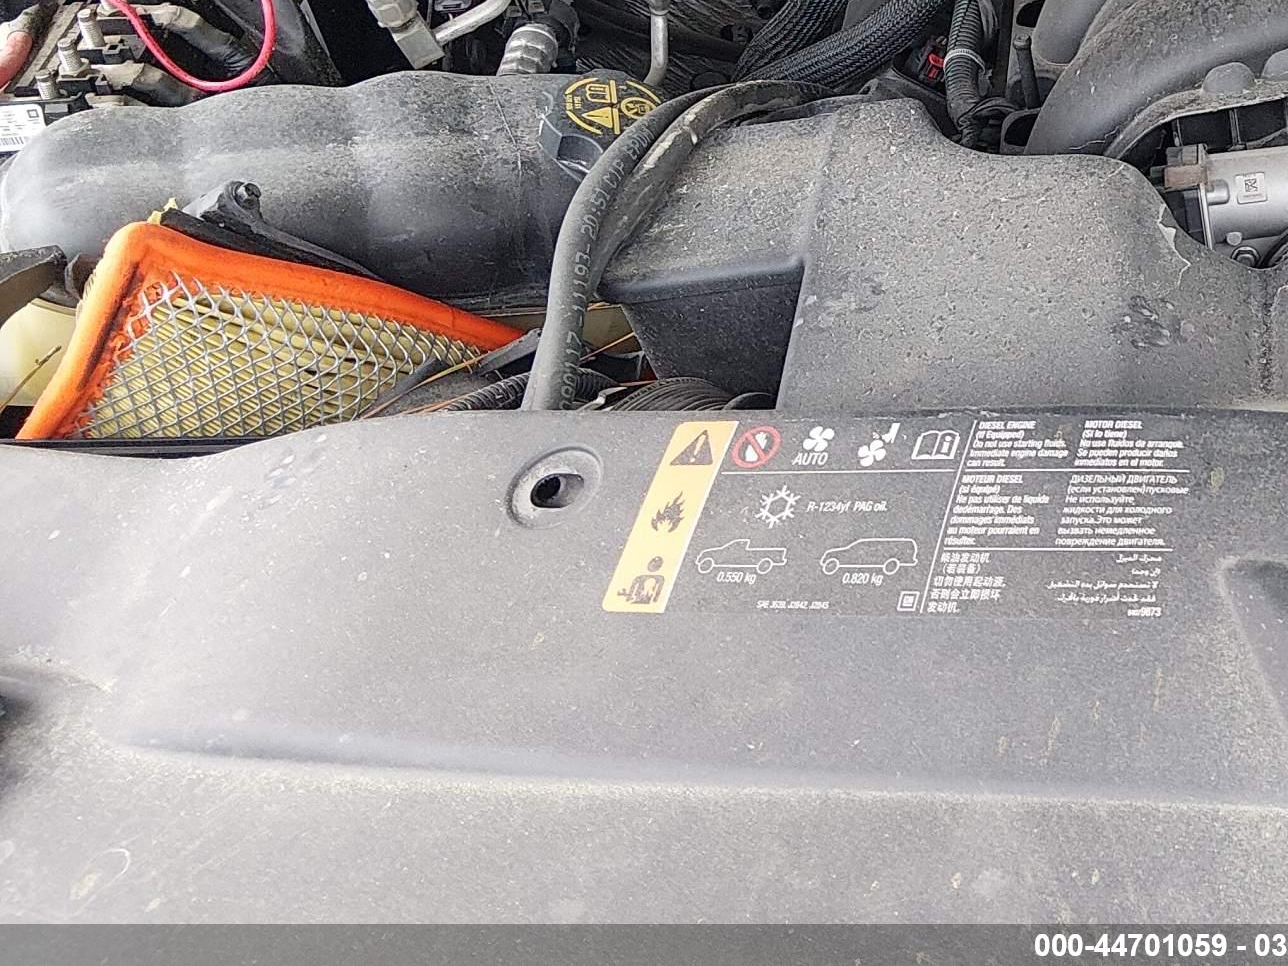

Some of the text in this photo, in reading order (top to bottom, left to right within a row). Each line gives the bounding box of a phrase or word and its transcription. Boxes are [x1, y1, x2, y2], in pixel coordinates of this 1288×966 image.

[979, 421, 1037, 429] DIESEL ENGINE
[1084, 420, 1143, 429] MOTOR DIESEL
[984, 440, 997, 448] not
[1013, 439, 1043, 450] starting
[1108, 439, 1134, 448] fluidos
[1135, 440, 1146, 448] de
[969, 450, 1068, 459] Immediate engine damage
[1077, 448, 1088, 457] Se
[1089, 449, 1118, 458] pueden
[1118, 449, 1152, 458] producir
[792, 452, 828, 466] AUTO
[1130, 458, 1138, 466] el
[962, 474, 1024, 483] MOTEUR DIESEL
[1070, 474, 1178, 484] ДИЗЕЛЬНЫЙ ДВИГАТЕЛЬ
[1068, 484, 1092, 494] (если
[956, 495, 1050, 504] Ne pas utiliser de liquide
[1065, 495, 1078, 503] Не
[806, 501, 850, 514] R-1234yf
[853, 501, 873, 512] PAG
[1006, 505, 1022, 513] Des
[1062, 506, 1172, 515] жидкости для холодного
[950, 515, 1035, 525] dommages immédiats
[1114, 516, 1142, 524] может
[958, 526, 987, 534] moteur
[988, 526, 1028, 536] pourraient
[1094, 527, 1156, 535] немедленное
[1055, 538, 1116, 547] повреждение
[940, 552, 991, 563] 柴油发动机
[716, 572, 757, 585] 0.550 kg
[842, 572, 884, 586] 0.820 kg
